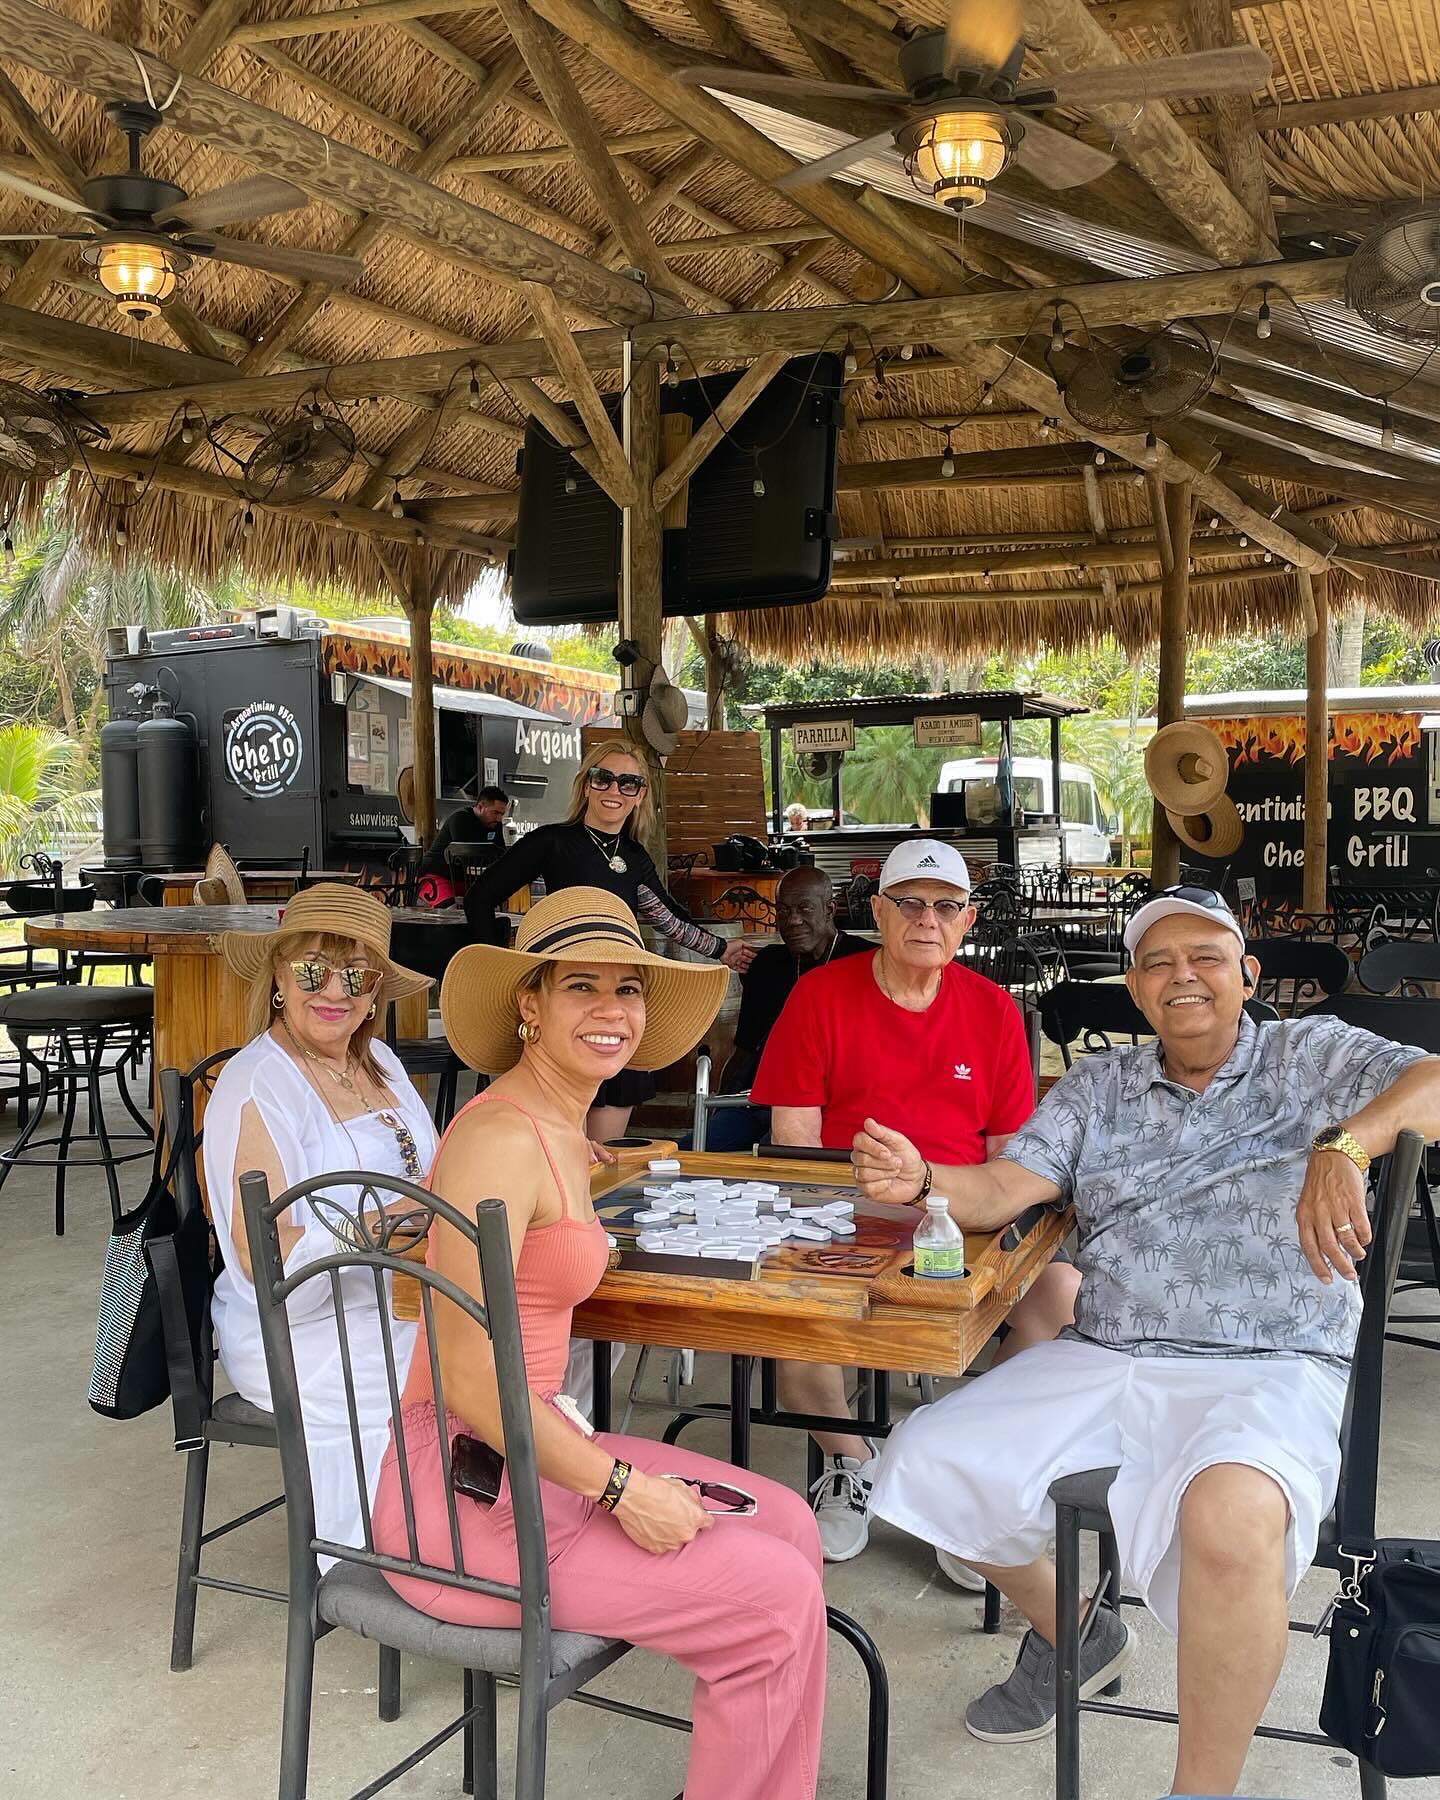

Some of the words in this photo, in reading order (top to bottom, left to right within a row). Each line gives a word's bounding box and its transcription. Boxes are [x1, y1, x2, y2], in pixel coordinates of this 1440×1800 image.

[230, 700, 275, 731] Argentinian
[278, 705, 294, 725] BBQ
[797, 727, 849, 744] PARRILLA
[231, 732, 295, 772] CheTo
[253, 763, 279, 783] Grill
[1354, 786, 1417, 823] BBQ
[1347, 835, 1409, 867] Grill
